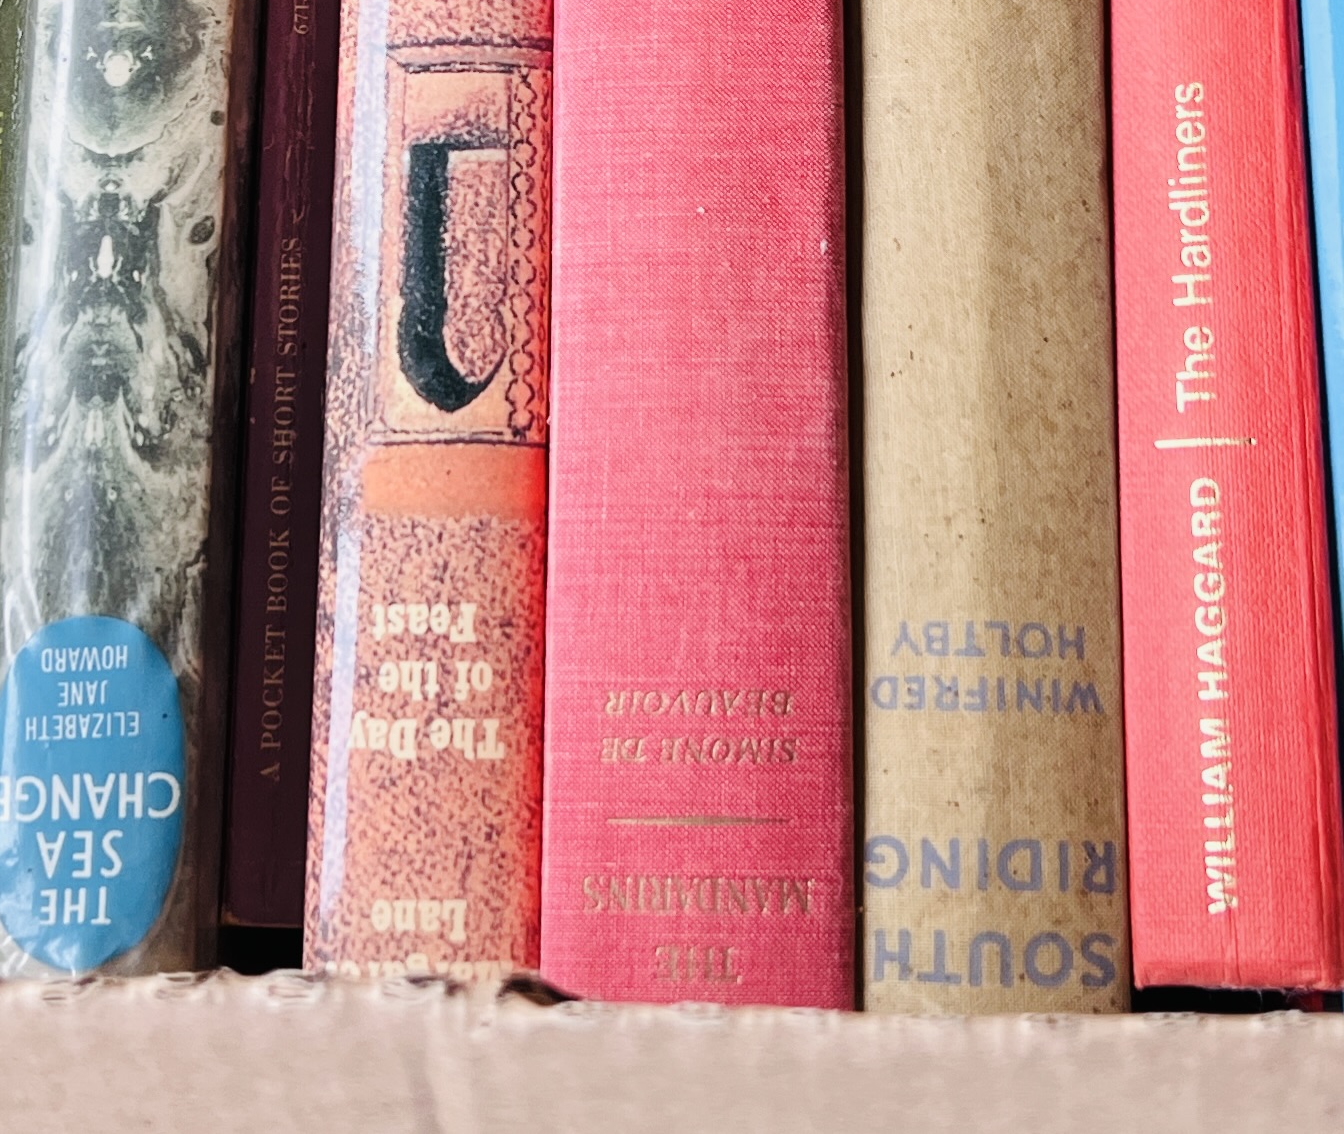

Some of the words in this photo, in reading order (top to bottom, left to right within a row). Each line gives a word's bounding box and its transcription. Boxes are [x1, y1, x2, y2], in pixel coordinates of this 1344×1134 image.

[1167, 81, 1213, 307] Hardliners
[276, 237, 303, 358] STORIES
[1175, 322, 1218, 413] The
[272, 366, 298, 466] SHORT
[270, 475, 293, 517] OF
[266, 527, 291, 614] BOOK
[1189, 476, 1228, 702] HAGGARD
[372, 602, 477, 643] Feast
[889, 620, 1087, 661] HOLTBY
[40, 645, 128, 673] HOWARD
[57, 680, 109, 707] JANE
[260, 624, 286, 752] POCKET
[379, 661, 439, 702] the
[454, 662, 493, 701] of
[870, 676, 1105, 715] WINIFRED
[604, 689, 794, 716] BEAUVOIR
[25, 711, 141, 741] ELIZABETH
[348, 711, 417, 759] Day
[430, 718, 506, 760] The
[600, 737, 648, 764] DE
[661, 737, 800, 765] SIMONE
[259, 761, 281, 783] A
[1198, 717, 1238, 916] WILLIAM
[36, 830, 124, 878] SEA
[863, 835, 1117, 895] RIDING
[39, 886, 112, 925] THE
[582, 874, 817, 915] MANDARINS
[371, 899, 468, 942] Lane
[653, 945, 743, 985] THE
[872, 928, 1118, 989] SOUTH
